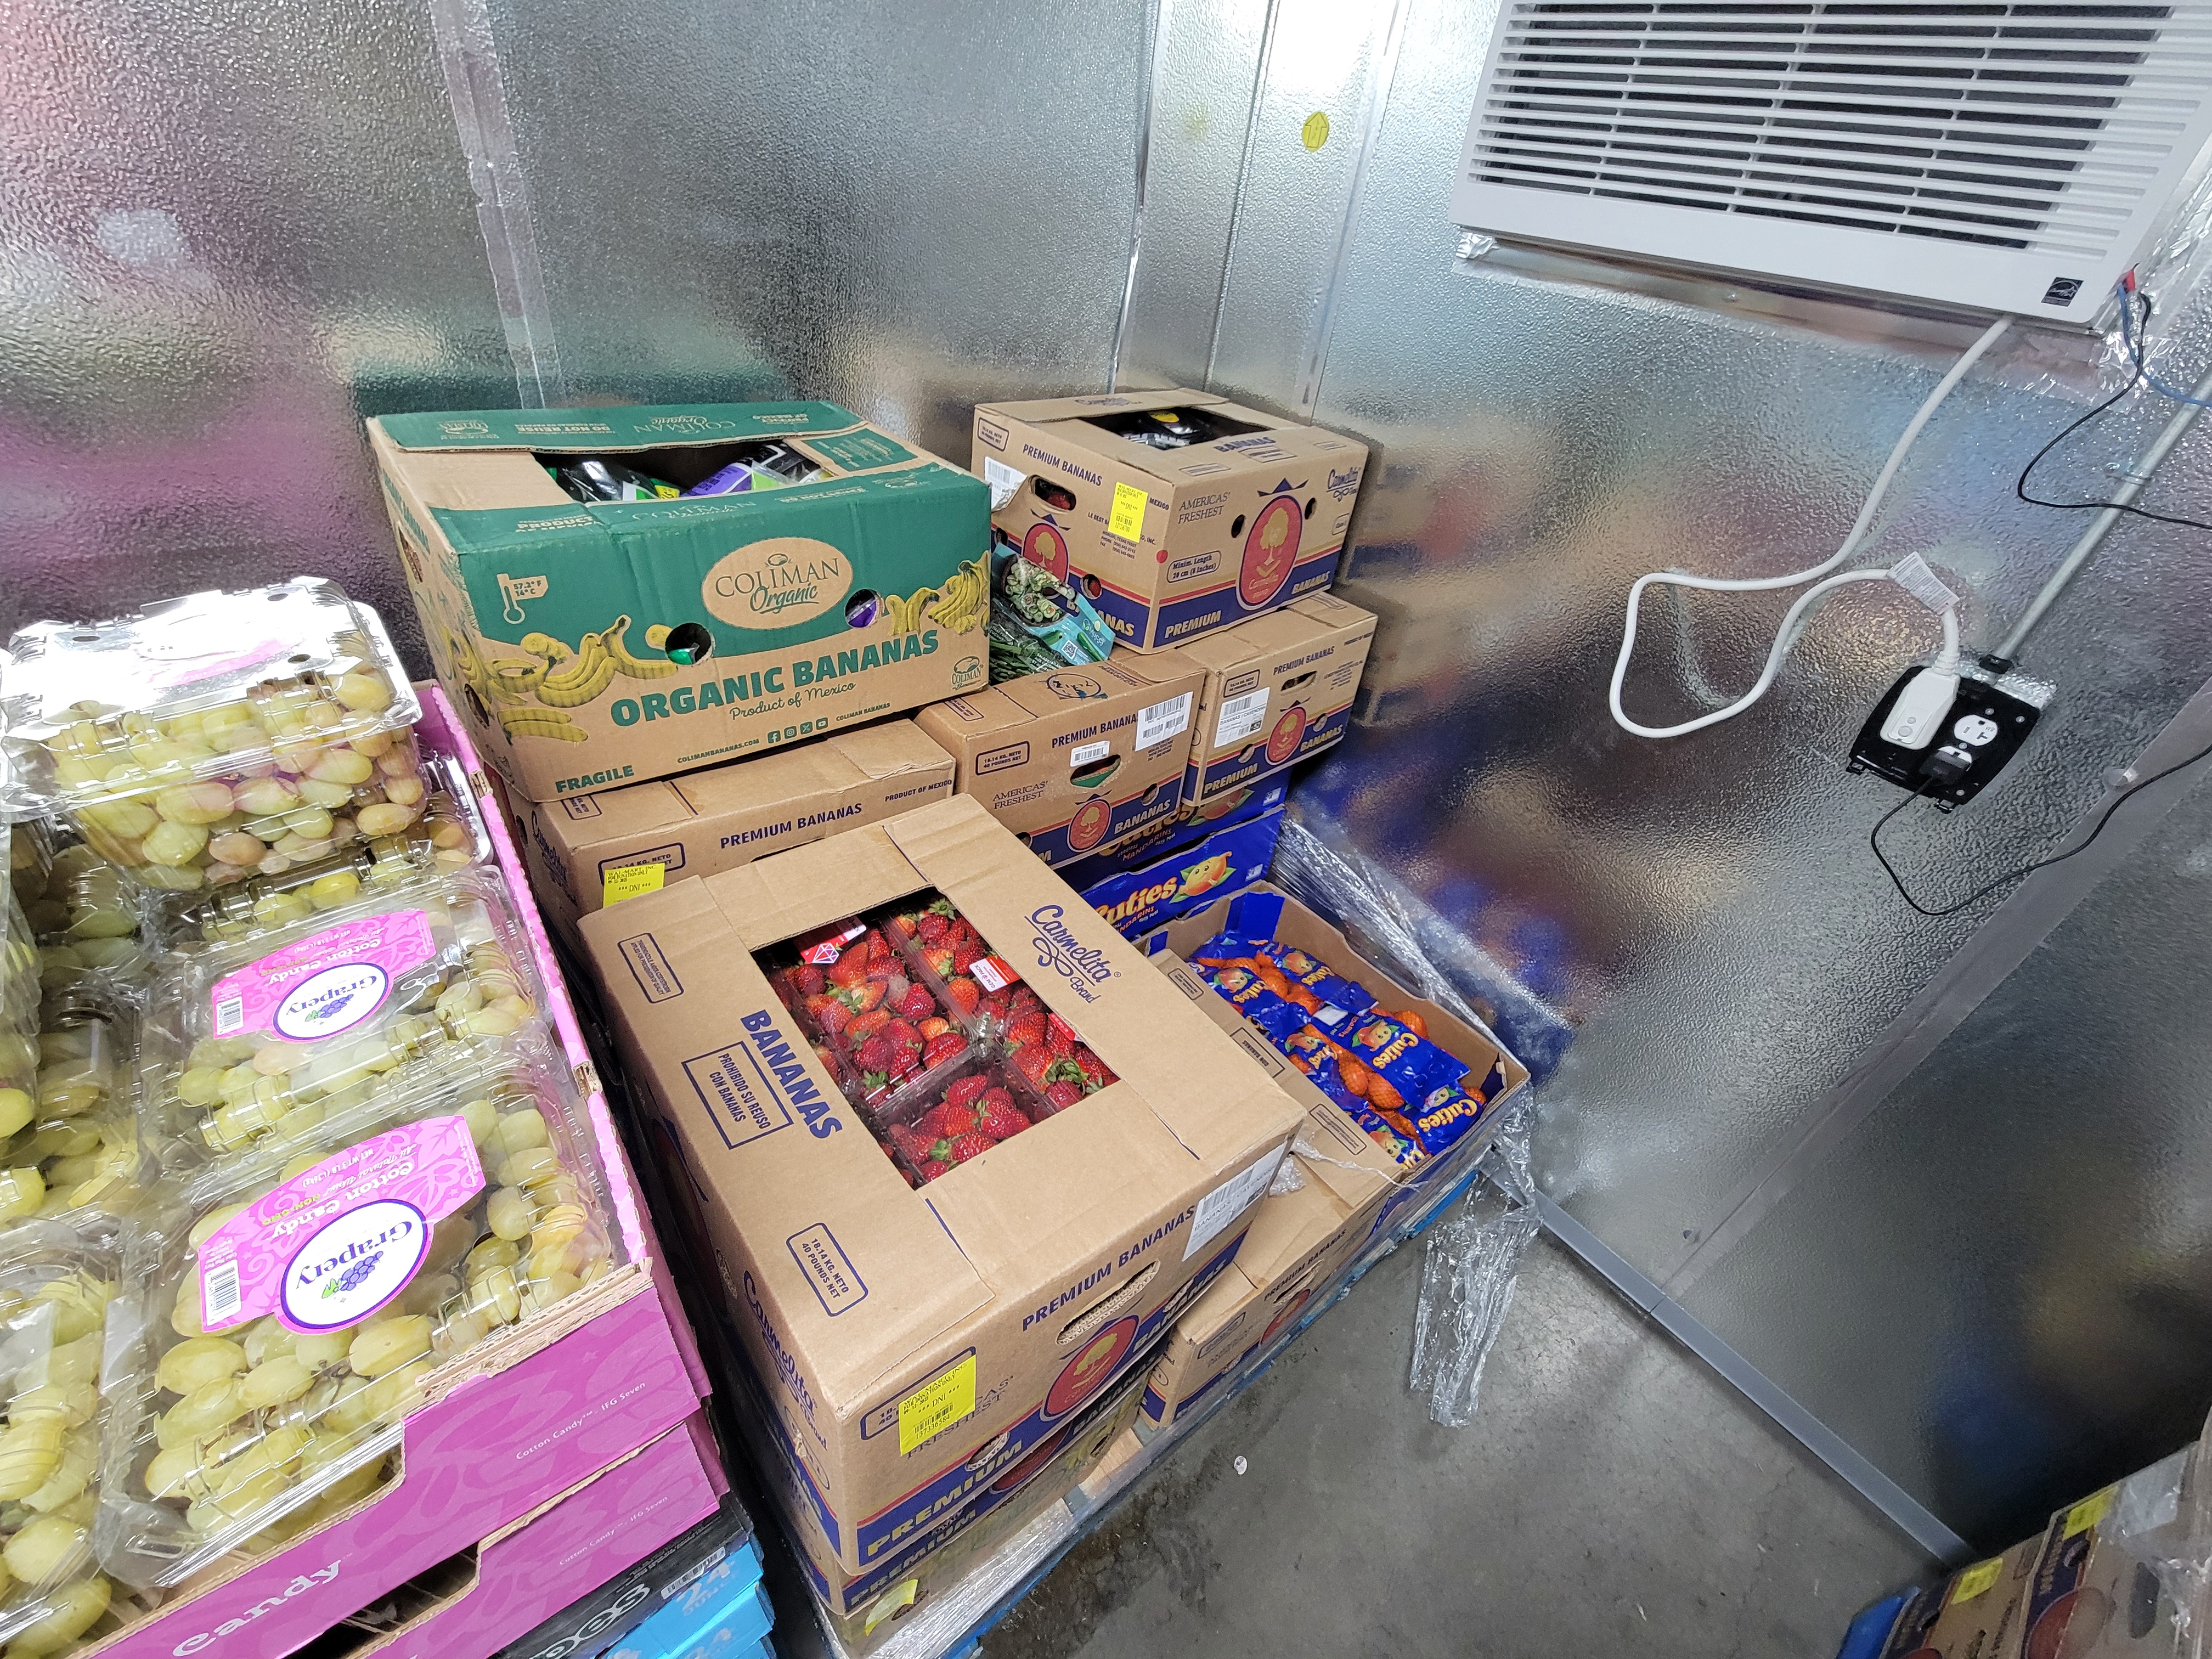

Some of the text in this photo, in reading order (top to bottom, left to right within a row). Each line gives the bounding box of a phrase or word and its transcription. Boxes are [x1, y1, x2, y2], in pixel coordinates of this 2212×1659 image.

[633, 420, 736, 433] COLIMAN
[1023, 443, 1103, 487] PREMIUM BANANAS
[1149, 498, 1169, 510] MEXICO
[1178, 492, 1231, 511] AMERICAS'
[1178, 505, 1224, 524] FRESHEST
[517, 516, 593, 529] PRODUCT
[1093, 515, 1104, 523] BEST
[715, 557, 840, 597] COLIMAN
[1172, 554, 1213, 570] Minim. Length
[749, 582, 820, 614] Organic
[1292, 571, 1330, 595] BANANAS
[1164, 610, 1222, 639] PREMIUM
[1273, 657, 1305, 676] PREMIUM
[1306, 645, 1335, 664] BANANAS
[611, 630, 939, 727] ORGANIC BANANAS
[729, 682, 856, 721] Product of Mexico
[1051, 726, 1098, 749] PREMIUM
[1300, 724, 1343, 752] BANANAS
[555, 765, 634, 793] FRAGILE
[884, 778, 952, 802] PRODUCT OF MEXICO
[992, 780, 1048, 802] AMERICAS'
[1204, 763, 1258, 794] PREMIUM
[994, 790, 1043, 810] FRESHEST
[720, 802, 862, 849] PREMIUM BANANAS
[1114, 799, 1171, 834] BANANAS
[652, 854, 671, 862] NETO
[1122, 828, 1172, 861] MANDARINS
[629, 883, 640, 892] DNI
[1116, 906, 1155, 933] NDARINS
[325, 938, 382, 962] Cotton
[1031, 905, 1112, 983] Carmelita
[265, 960, 322, 986] Candy
[285, 974, 378, 1015] Grapery
[1069, 976, 1102, 1004] Brand
[1372, 1032, 1419, 1070] Cuties
[740, 1009, 843, 1139] BANANAS
[709, 1071, 747, 1123] CON BANANAS
[718, 1053, 771, 1130] PROHIBIDO SU REUSO
[1417, 1098, 1478, 1132] Cuties
[273, 1161, 414, 1237] Cotton Candy
[1118, 1205, 1197, 1268] BANANAS
[295, 1221, 413, 1290] Grapery
[802, 1243, 841, 1299] 40 POUNDS NET
[811, 1238, 849, 1293] 18.14 KG. NETO
[1022, 1261, 1112, 1332] PREMIUM
[880, 1407, 896, 1418] 18.
[932, 1393, 946, 1408] DNI
[516, 1382, 646, 1460] Cotton IFG Seven
[878, 1415, 893, 1425] 40
[907, 1390, 1006, 1459] FRESHEST
[867, 1439, 1023, 1556] PREMIUM
[559, 1547, 588, 1566] Cotton
[630, 1510, 645, 1522] IFG
[645, 1496, 668, 1513] Seven
[172, 1559, 342, 1657] Candy
